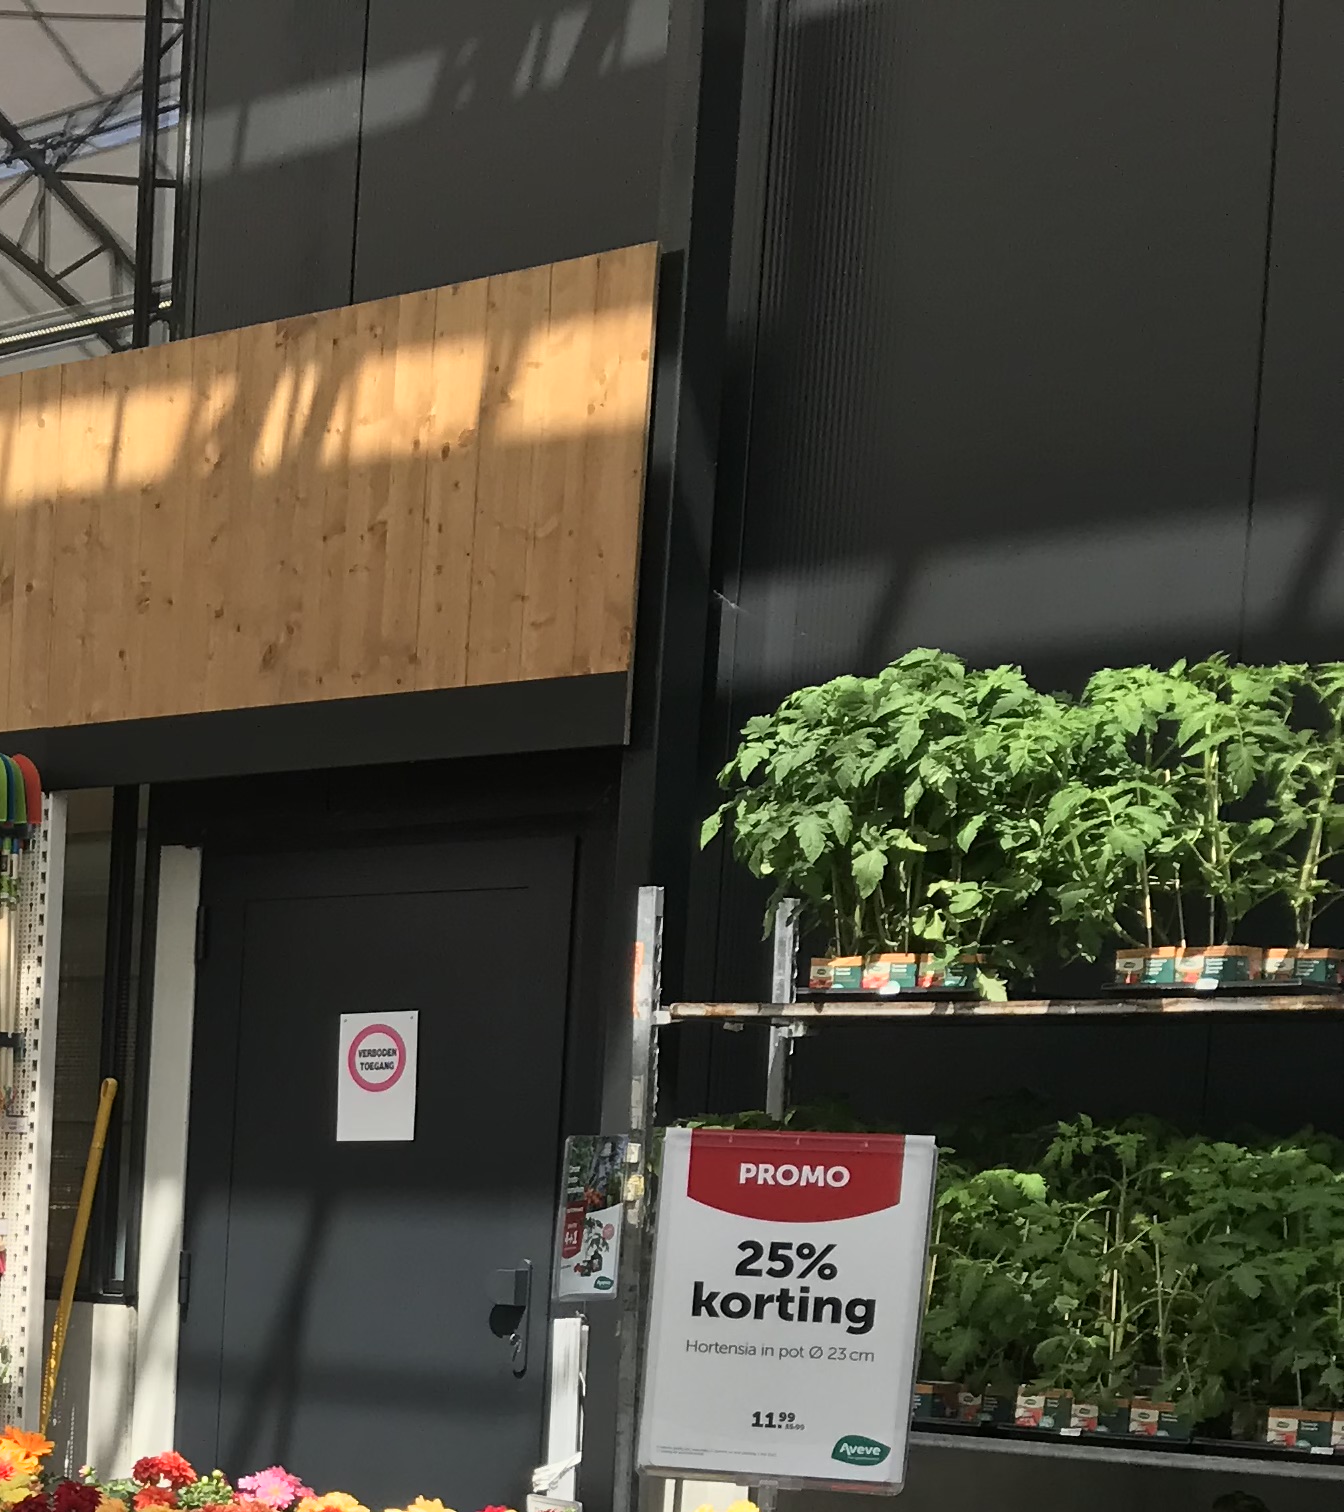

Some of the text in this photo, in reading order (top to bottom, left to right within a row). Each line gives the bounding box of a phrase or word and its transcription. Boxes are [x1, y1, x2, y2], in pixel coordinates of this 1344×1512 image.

[358, 1048, 397, 1058] VERBODEN
[360, 1061, 394, 1071] TOEGANG
[738, 1162, 850, 1187] PROMO
[734, 1240, 838, 1280] 25%
[691, 1281, 877, 1335] korting
[686, 1338, 757, 1358] Hortensia
[760, 1342, 775, 1358] in
[778, 1344, 805, 1362] pot
[827, 1346, 847, 1362] 23
[849, 1349, 875, 1362] cm
[839, 1442, 881, 1456] Aveve
